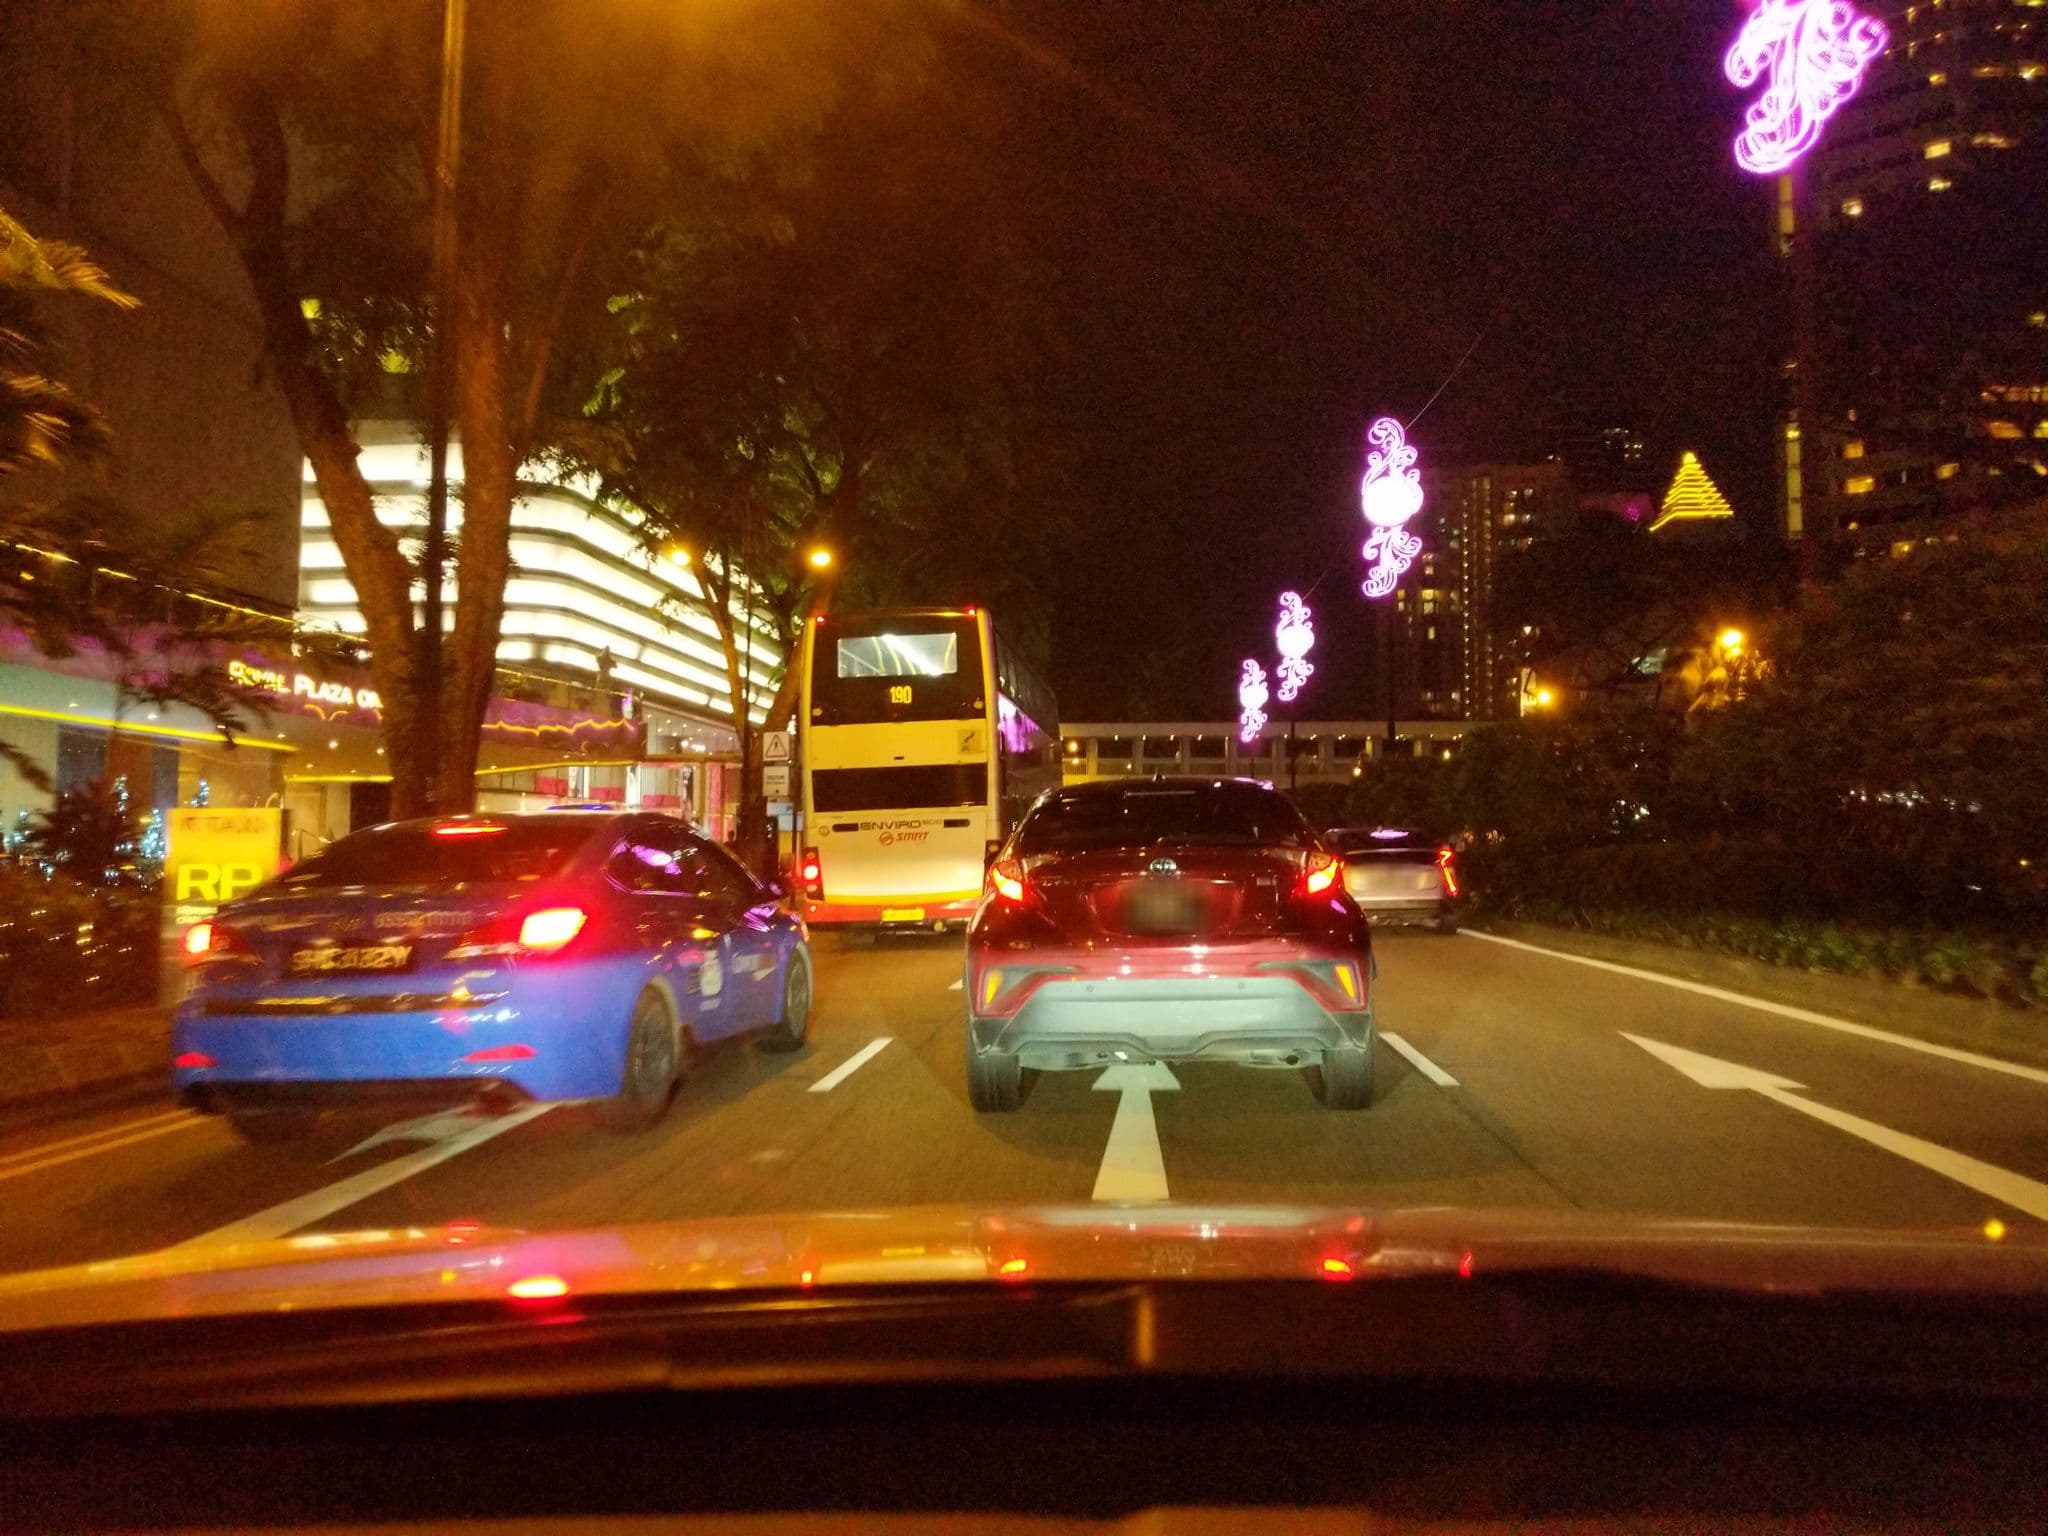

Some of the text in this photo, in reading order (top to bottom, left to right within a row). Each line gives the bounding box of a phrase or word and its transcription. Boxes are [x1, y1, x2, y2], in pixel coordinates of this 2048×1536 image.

[294, 673, 354, 705] PLAZA
[890, 685, 912, 704] 190
[860, 820, 921, 831] ENVIRO
[176, 863, 262, 901] RP
